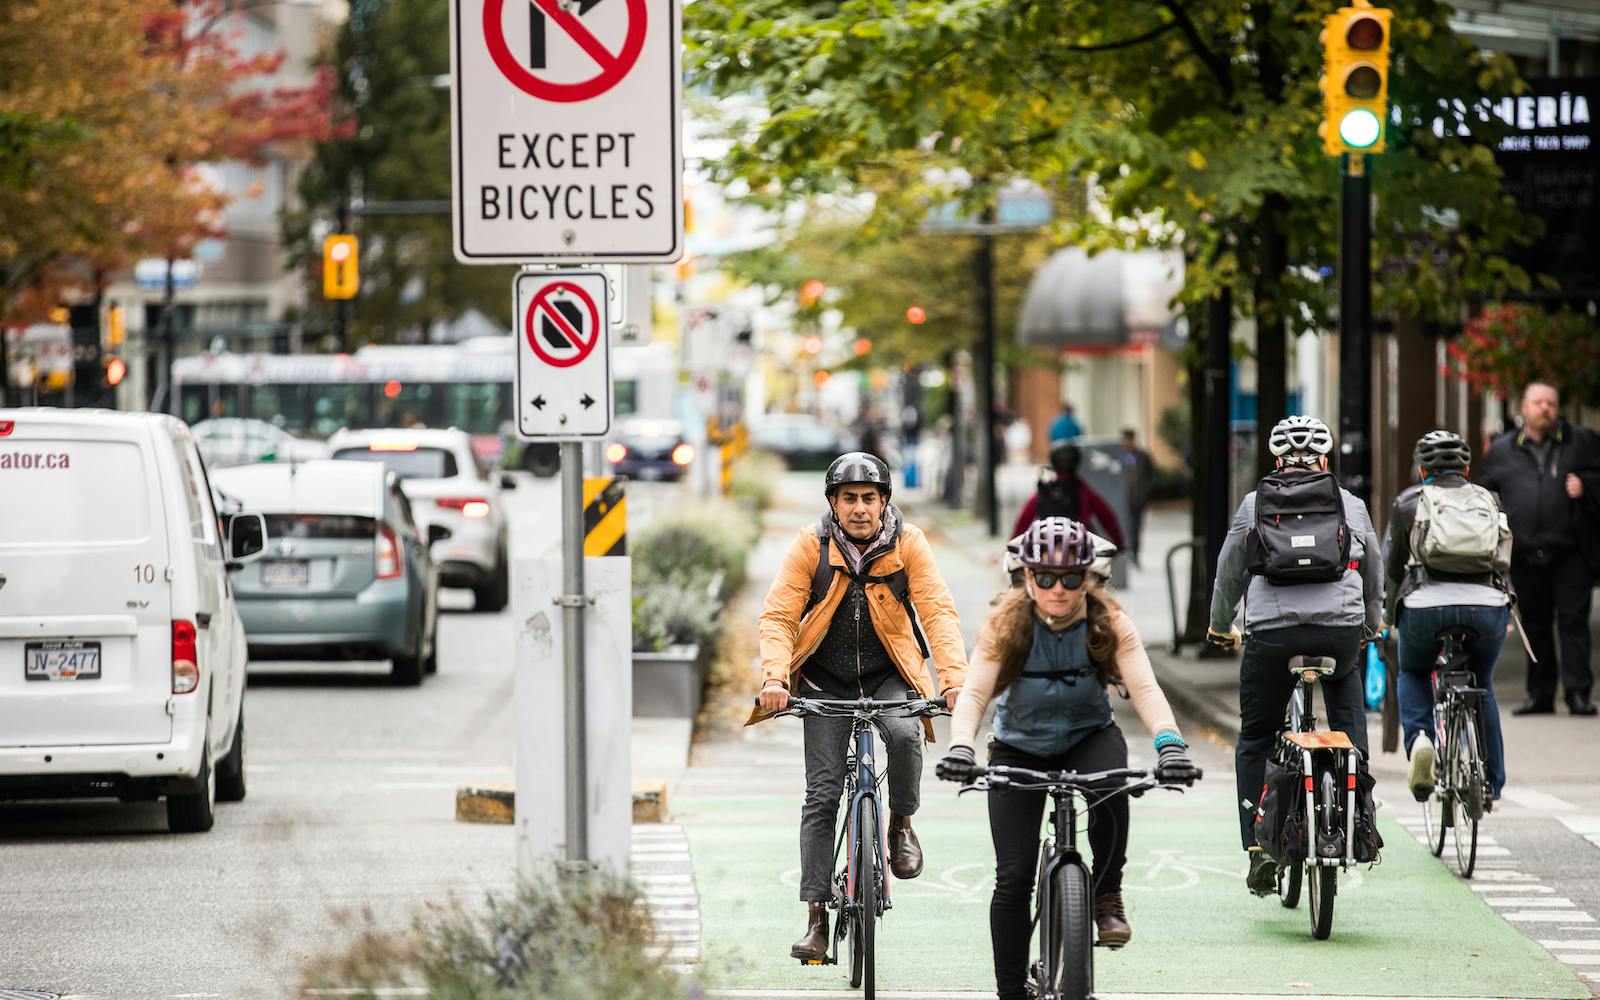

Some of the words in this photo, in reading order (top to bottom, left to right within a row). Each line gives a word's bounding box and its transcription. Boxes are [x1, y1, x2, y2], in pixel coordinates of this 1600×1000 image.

[498, 132, 635, 169] EXCEPT
[481, 184, 655, 220] BICYCLES
[1, 452, 70, 469] ator.ca
[134, 563, 155, 584] 10
